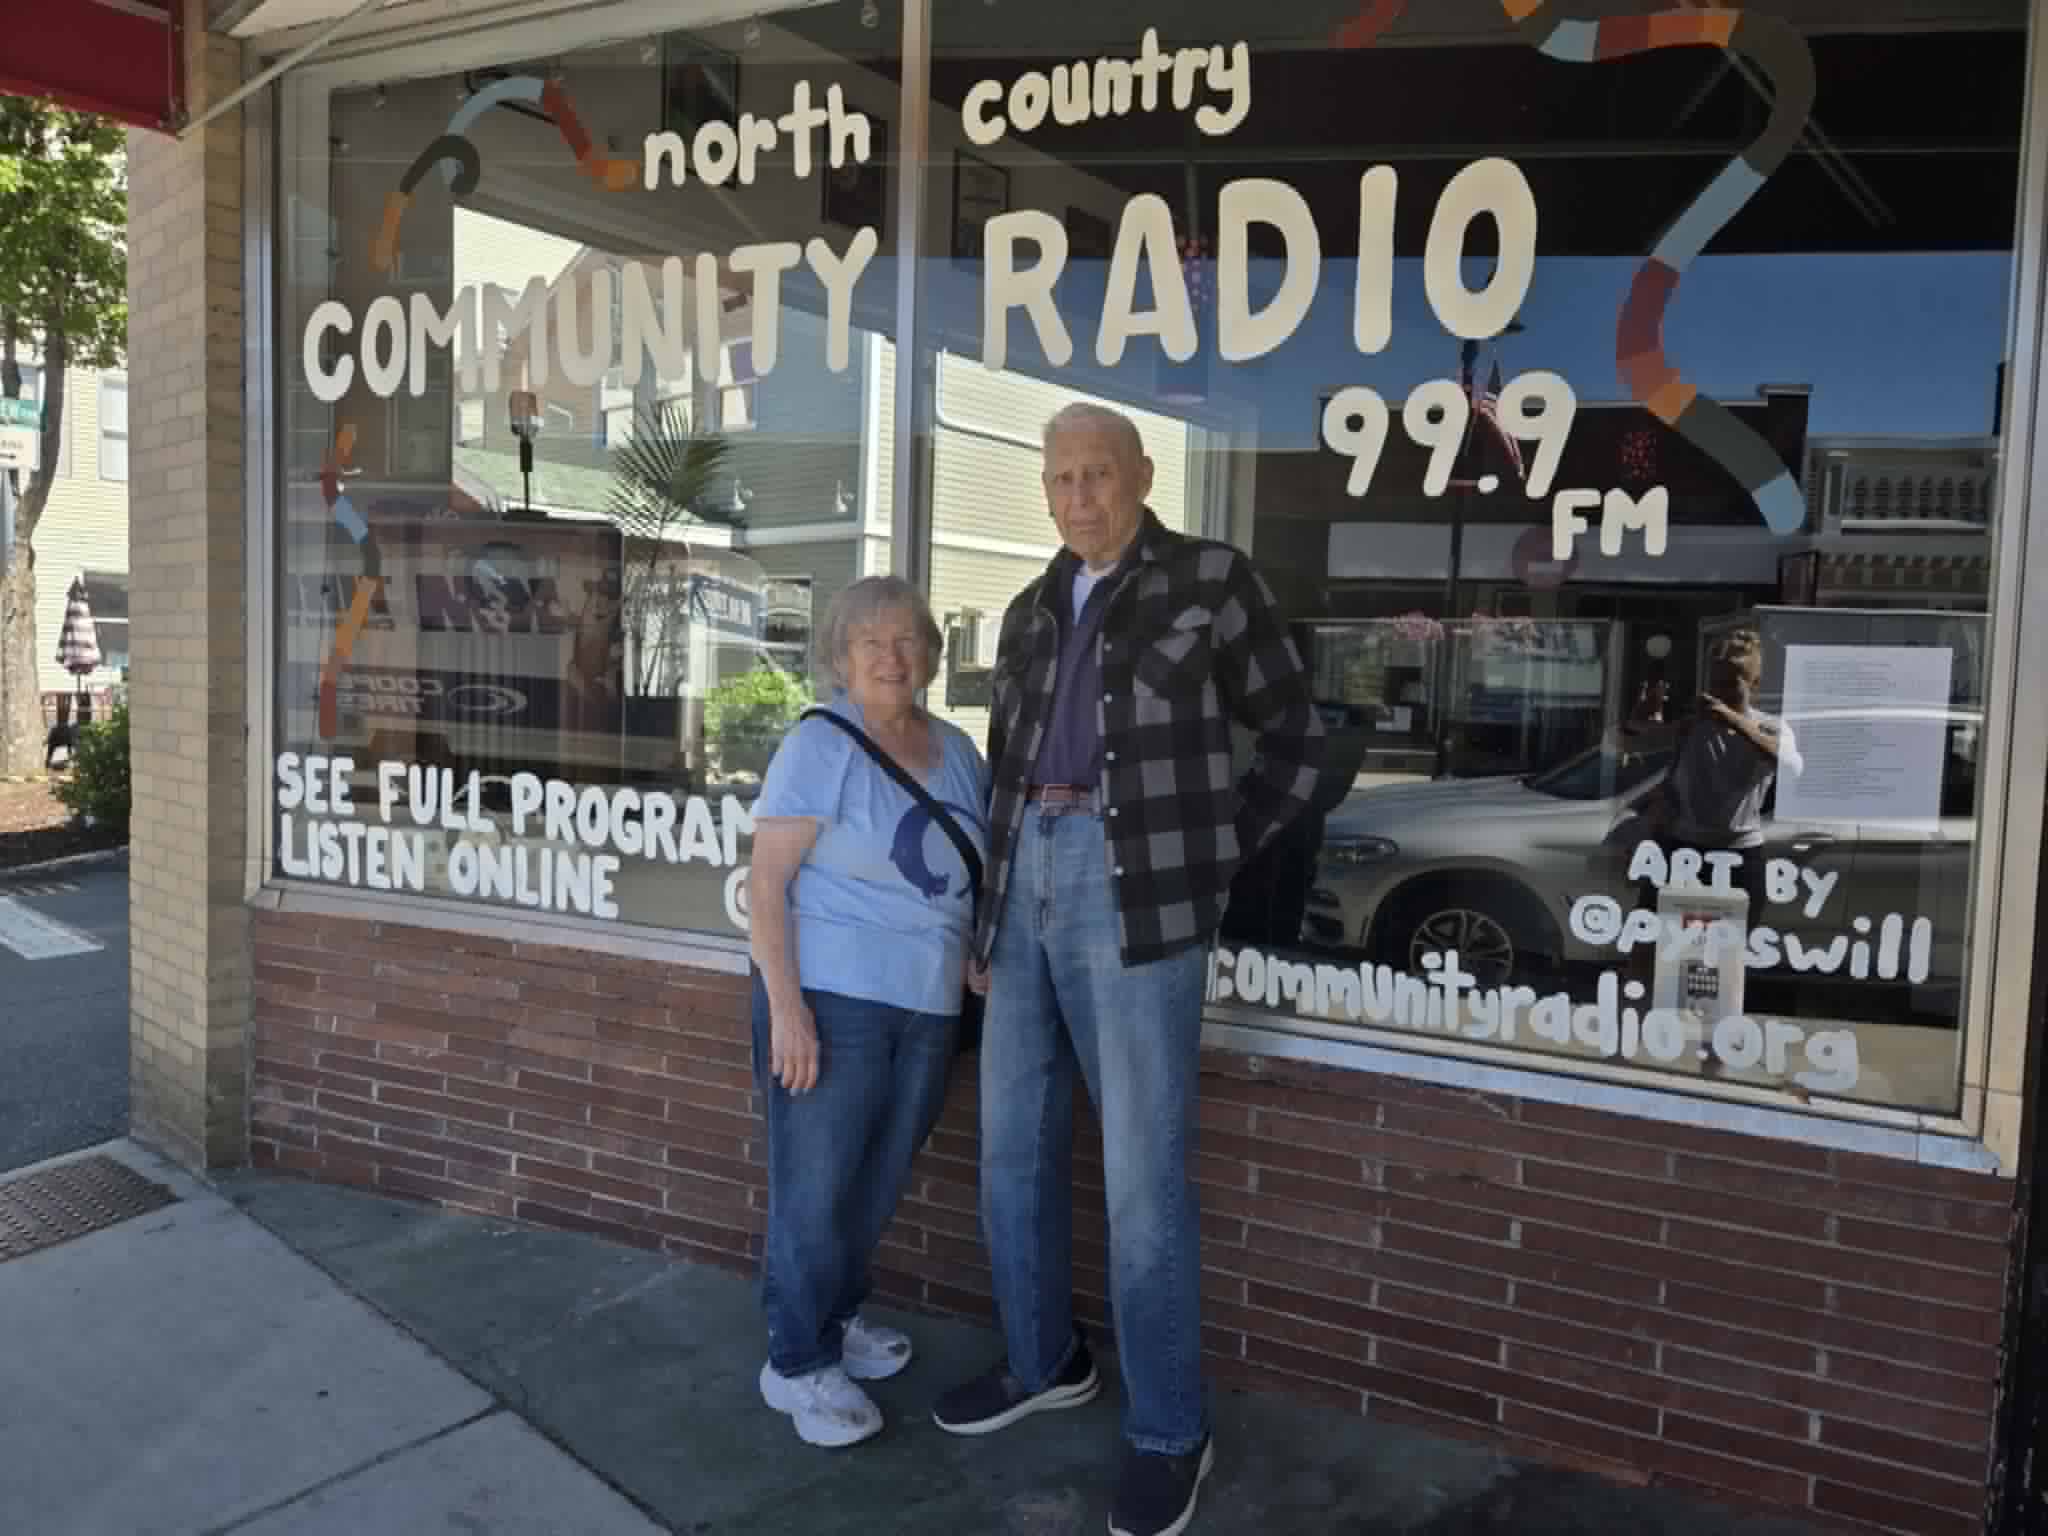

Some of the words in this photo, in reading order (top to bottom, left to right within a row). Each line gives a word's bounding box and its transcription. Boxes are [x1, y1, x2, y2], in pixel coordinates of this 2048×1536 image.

[644, 80, 872, 190] north
[962, 28, 1251, 144] country
[303, 227, 877, 402] COMMUNITY
[981, 157, 1538, 371] RADIO
[1322, 370, 1577, 498] 99.9
[1552, 485, 1669, 561] FM
[276, 752, 355, 815] SEE
[378, 760, 497, 833] FULL
[280, 813, 425, 892] LISTEN
[448, 841, 620, 919] ONLINE
[1628, 840, 1744, 896] ART
